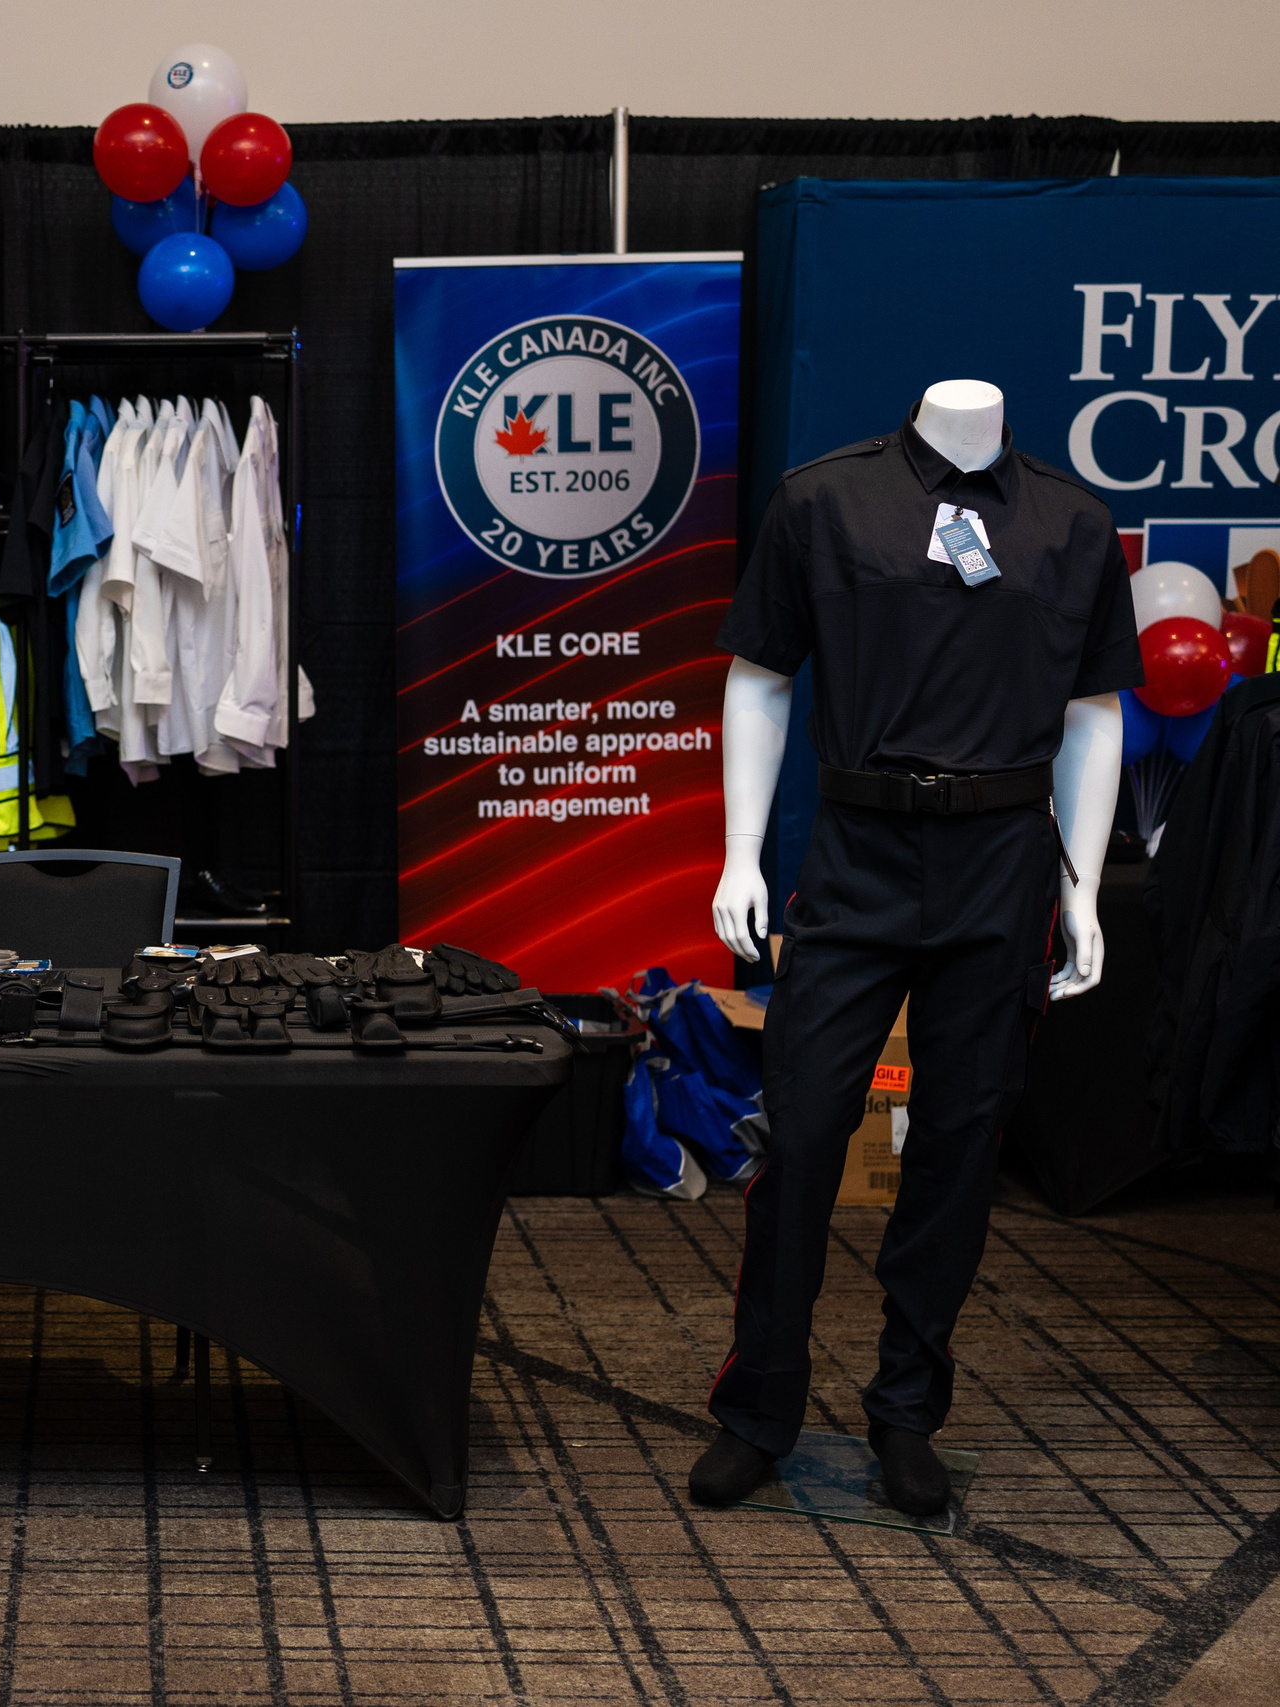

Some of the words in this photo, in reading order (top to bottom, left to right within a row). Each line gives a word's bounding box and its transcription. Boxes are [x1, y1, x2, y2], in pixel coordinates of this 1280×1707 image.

[1069, 283, 1280, 381] FLY
[453, 366, 500, 418] KLE
[499, 326, 628, 370] CANADA
[632, 352, 680, 407] INC
[494, 390, 635, 456] KLE
[510, 471, 561, 494] EST.
[565, 469, 630, 492] 2006
[479, 518, 522, 558] 20
[535, 512, 656, 570] YEARS
[496, 633, 551, 658] KLE
[559, 632, 640, 657] CORE
[460, 699, 482, 723] A
[488, 698, 599, 724] smarter,
[607, 700, 677, 720] more
[423, 730, 578, 755] sustainable
[584, 727, 712, 757] approach
[498, 763, 526, 786] to
[533, 761, 637, 785] uniform
[478, 793, 651, 823] management
[876, 1067, 907, 1082] GILE
